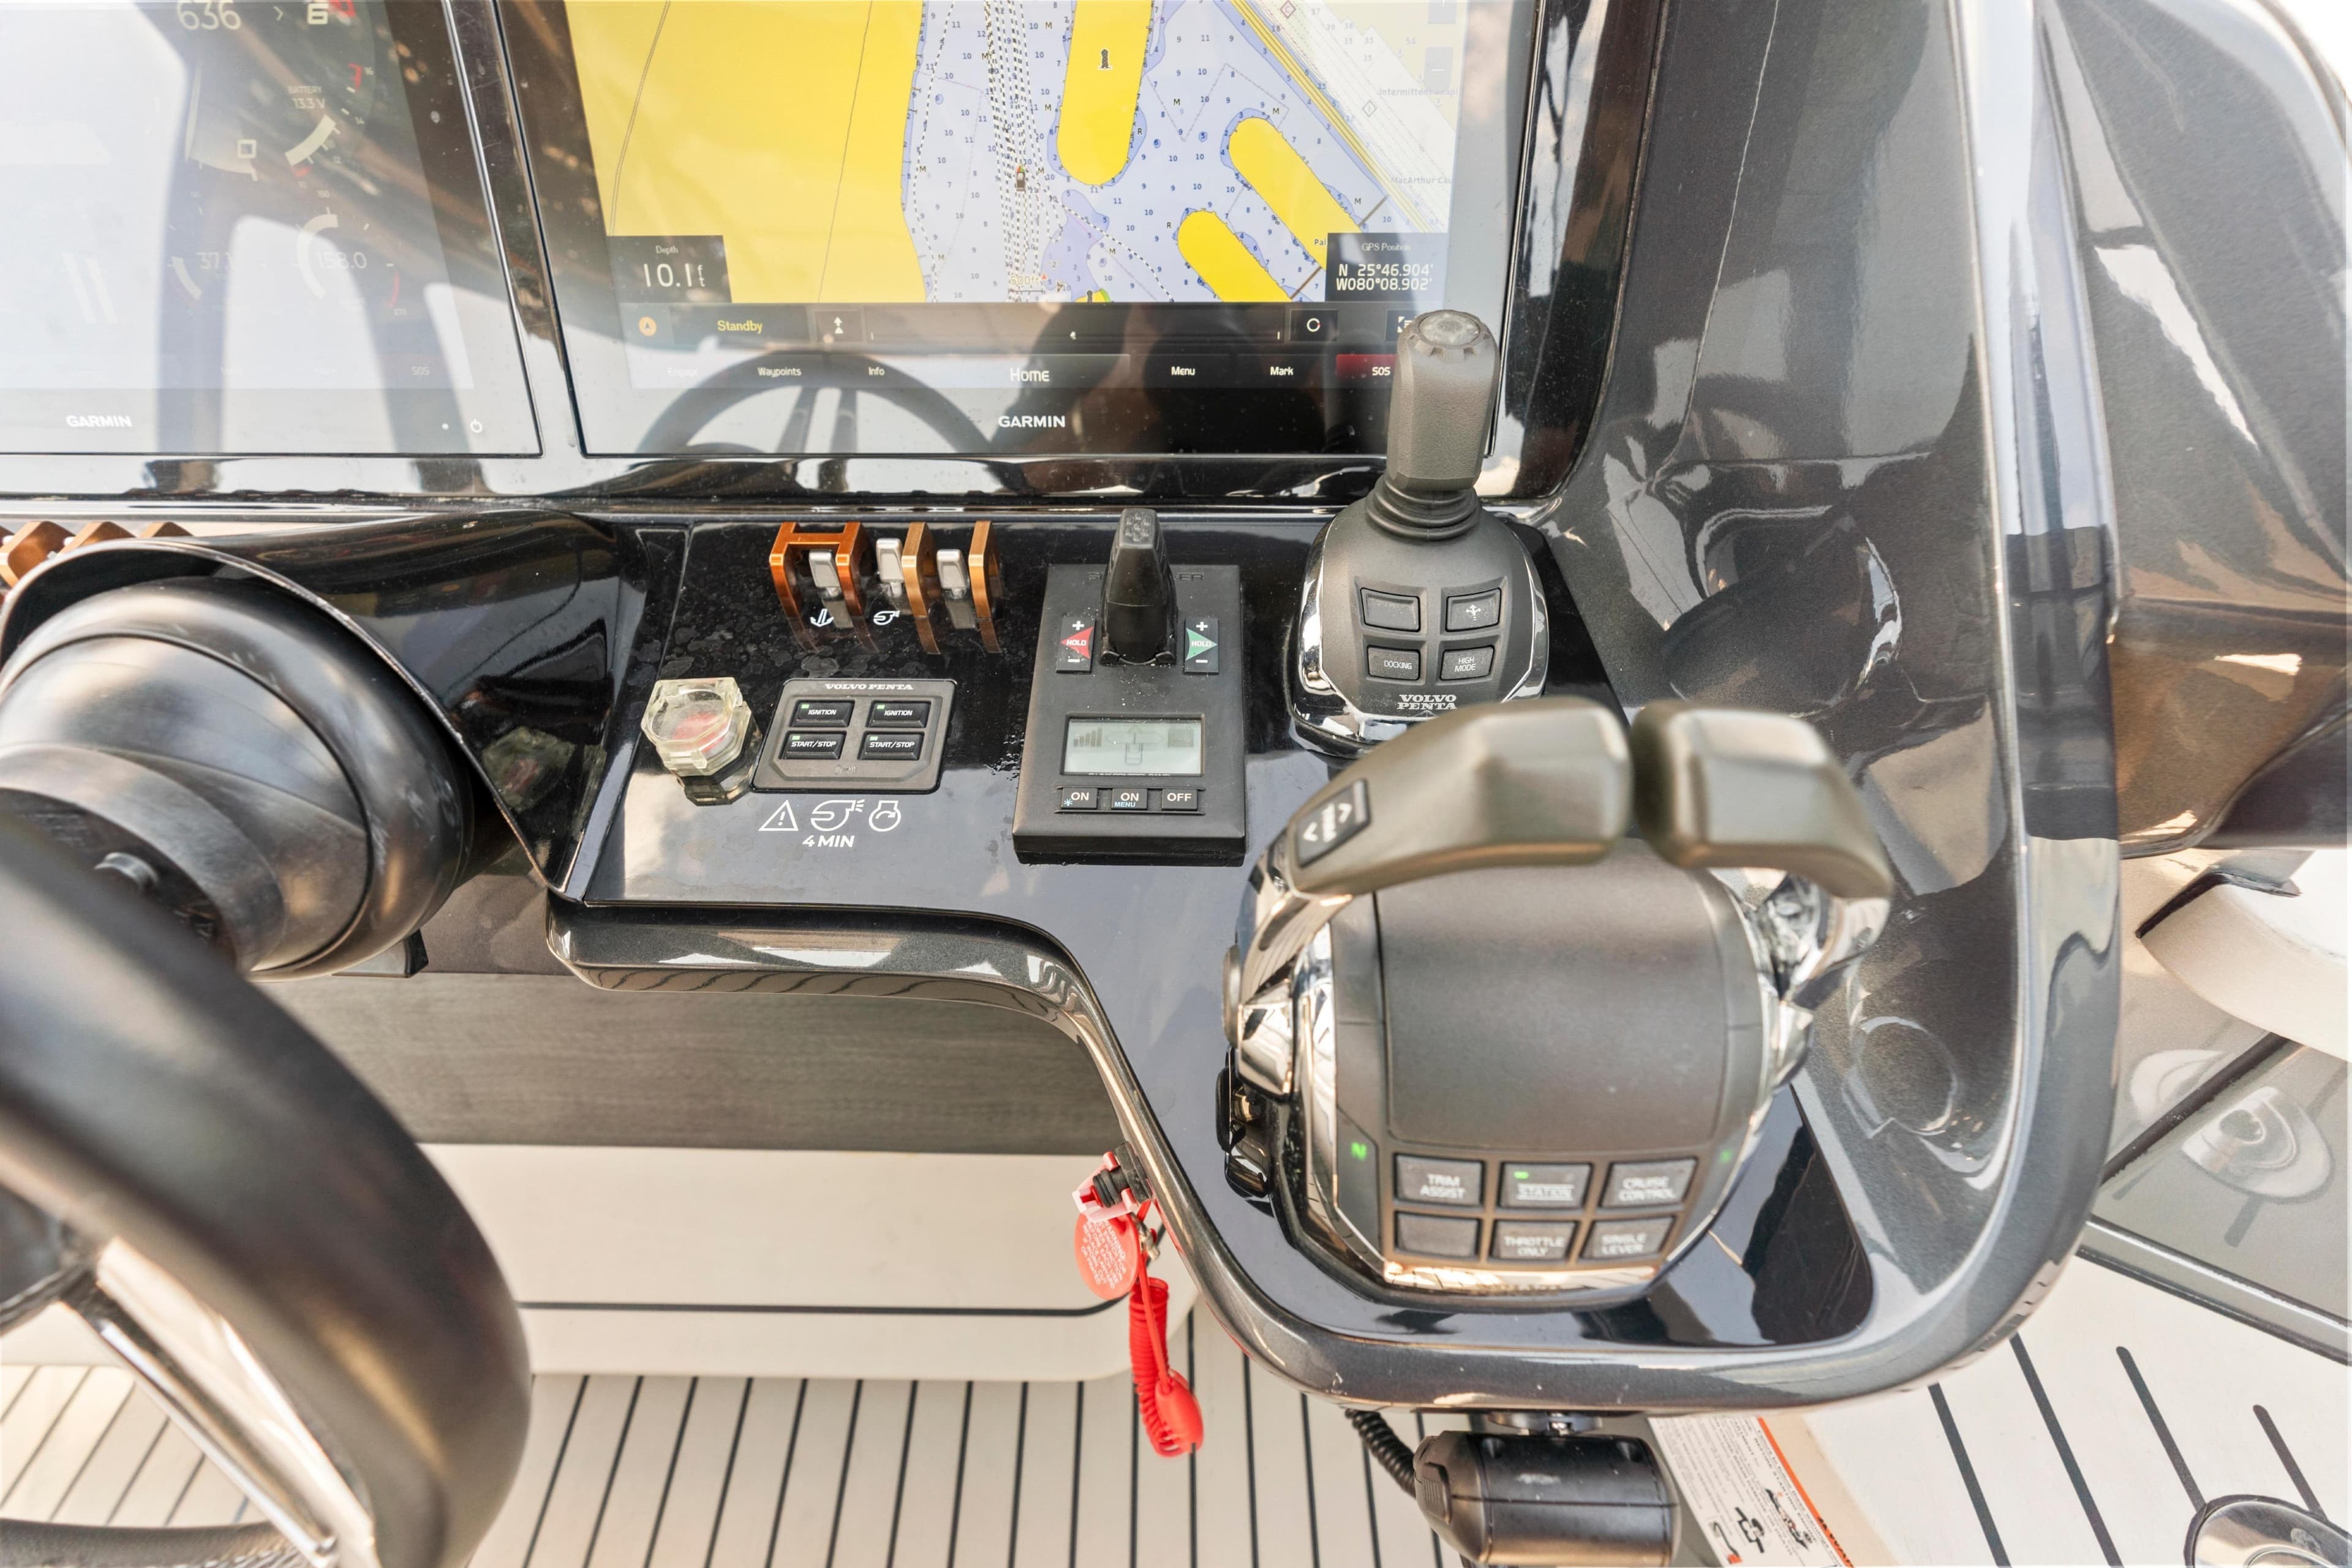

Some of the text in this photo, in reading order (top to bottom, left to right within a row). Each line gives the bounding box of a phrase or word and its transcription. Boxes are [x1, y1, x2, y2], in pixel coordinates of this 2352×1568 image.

[177, 0, 241, 30] 636
[655, 245, 678, 255] Depth
[1362, 243, 1412, 252] GPS Position
[643, 263, 692, 287] 10.1
[1338, 263, 1348, 277] N
[717, 319, 763, 334] Standby
[758, 366, 801, 377] Waypoints
[869, 366, 884, 375] Info
[1009, 368, 1050, 382] Home
[1171, 366, 1195, 375] Menu
[1270, 366, 1294, 375] Mark
[1372, 366, 1390, 375] SOS
[66, 415, 132, 428] GARMIN
[998, 415, 1066, 428] GARMIN
[1384, 660, 1412, 669] DOCKING
[1071, 792, 1090, 801] ON
[1120, 793, 1139, 802] ON
[1167, 793, 1192, 802] OFF
[802, 835, 855, 847] 4 MIN
[1427, 1174, 1461, 1186] TRIM
[1622, 1176, 1670, 1189] CRUISE
[1420, 1184, 1466, 1199] ASSIST
[1504, 1236, 1564, 1248] THROTTLE
[1601, 1232, 1648, 1245] SINGLE
[1517, 1246, 1549, 1257] ONLY
[1601, 1244, 1644, 1256] LEVER
